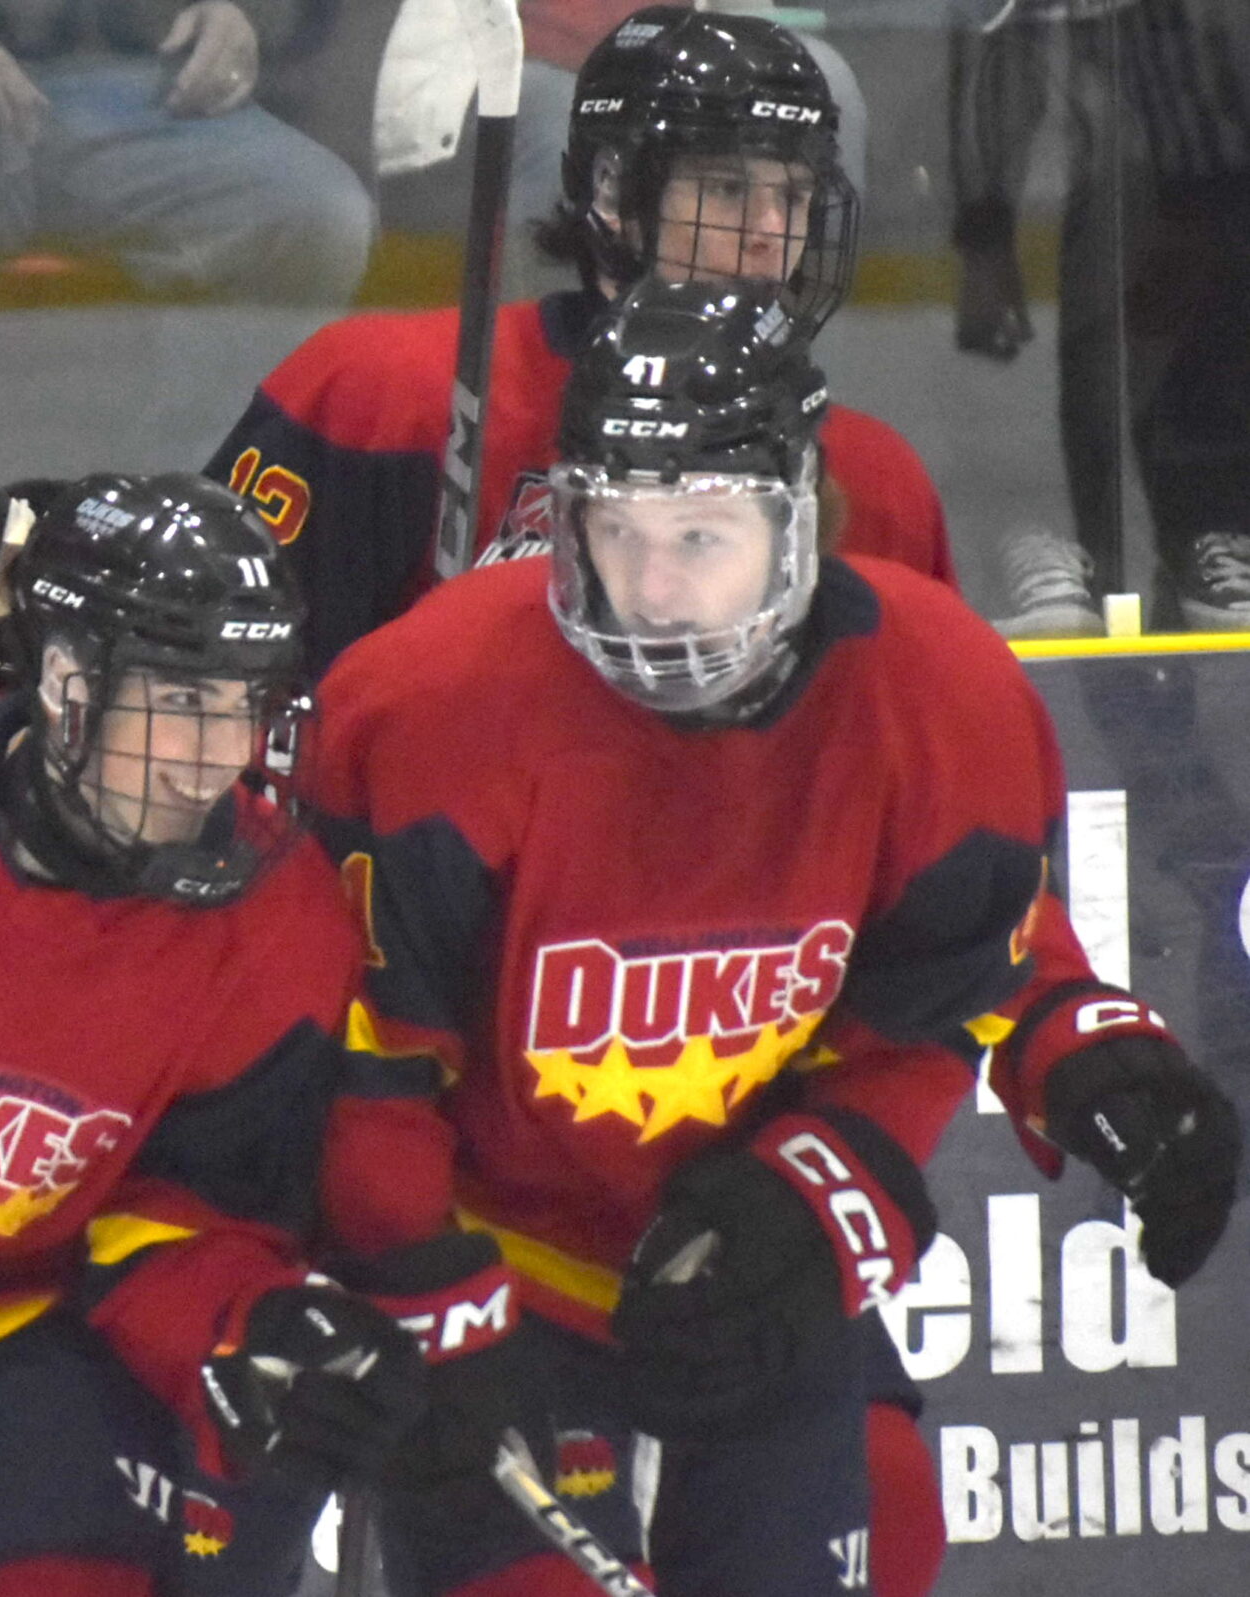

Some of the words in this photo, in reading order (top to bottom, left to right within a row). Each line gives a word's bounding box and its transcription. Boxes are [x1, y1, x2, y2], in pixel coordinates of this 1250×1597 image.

[579, 98, 623, 114] CCM
[751, 100, 822, 124] CCM
[622, 354, 666, 387] 41
[602, 418, 689, 439] CCM
[237, 556, 270, 588] 11
[31, 577, 86, 611] CCM
[220, 620, 293, 641] CCM
[528, 920, 855, 1055] DUKES
[777, 1132, 894, 1314] CCM
[940, 1415, 1250, 1544] Builds
